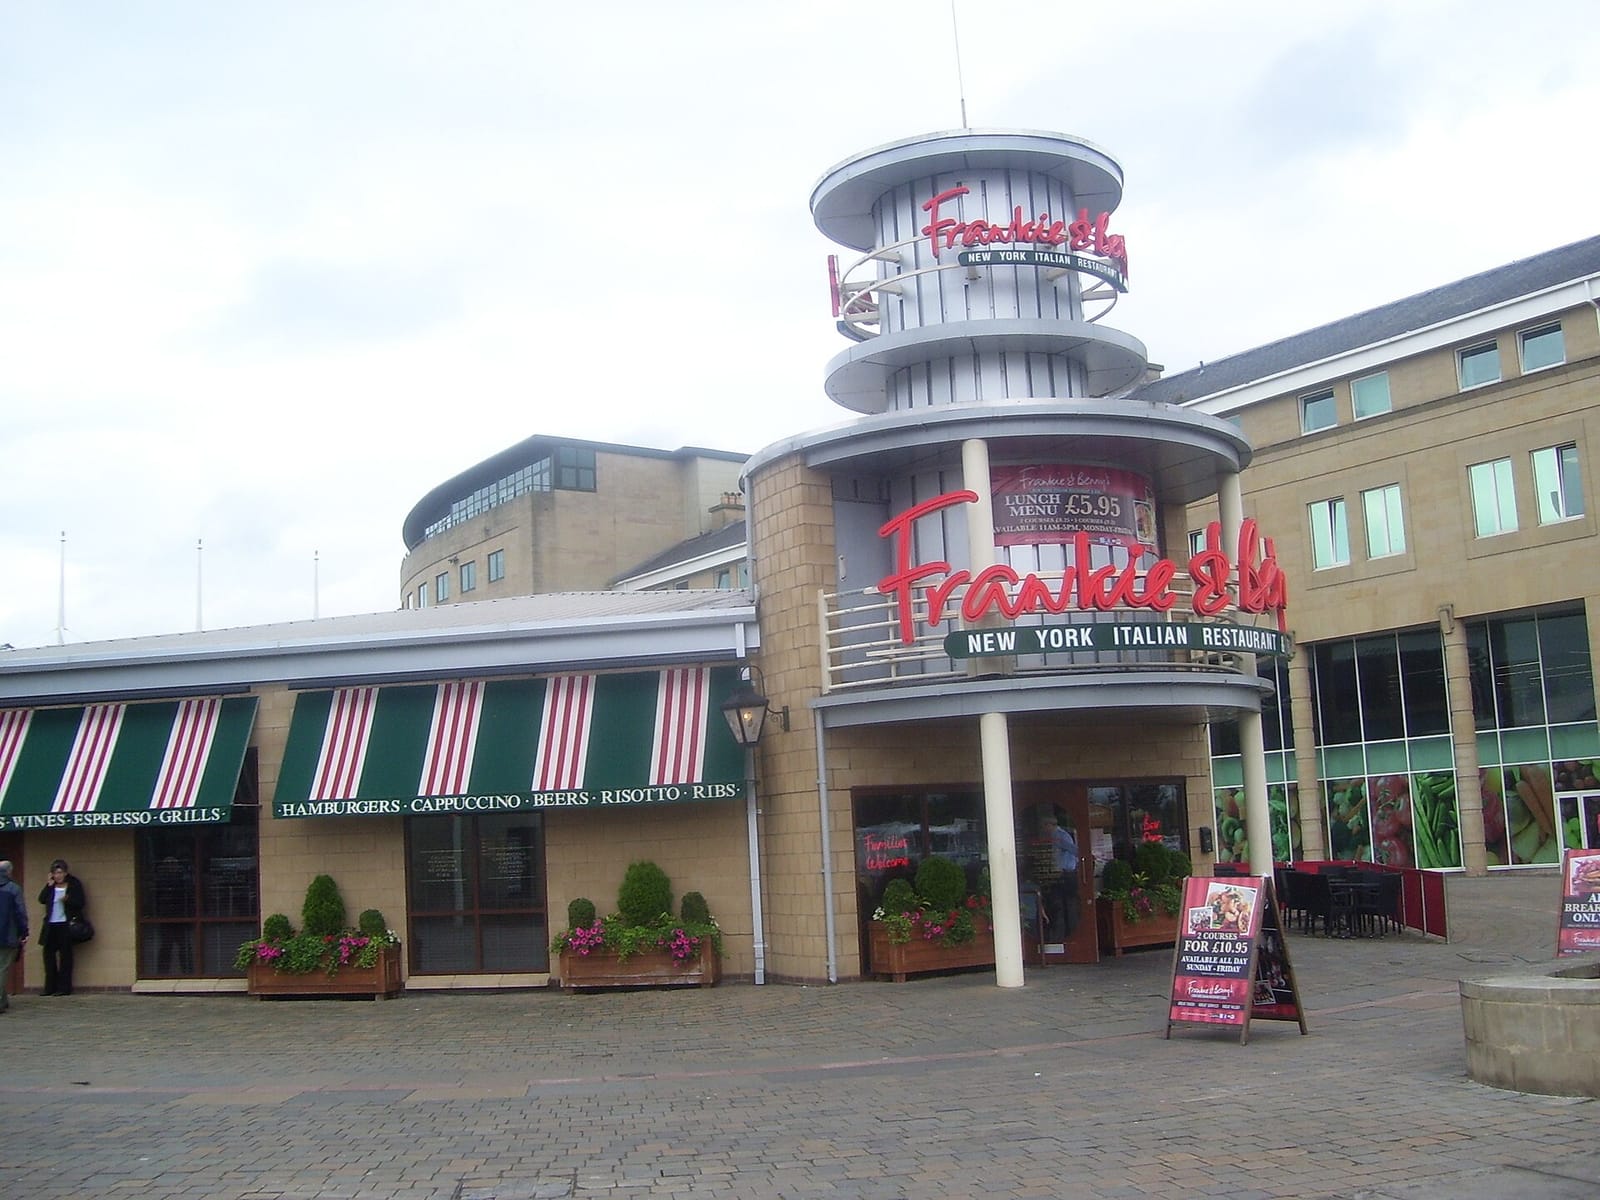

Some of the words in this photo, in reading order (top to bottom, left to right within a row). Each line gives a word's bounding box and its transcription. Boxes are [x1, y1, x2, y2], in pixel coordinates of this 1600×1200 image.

[922, 186, 1067, 258] Frankie
[968, 253, 991, 263] NEW
[1000, 251, 1026, 261] YORK
[1035, 252, 1071, 265] ITALIAN
[1077, 258, 1118, 280] RESTAURANT
[1019, 466, 1067, 489] Frankie
[1005, 493, 1061, 506] LUNCH
[1065, 494, 1121, 517] £5.95
[1009, 505, 1058, 517] MENU
[877, 489, 1177, 645] Frankie
[1188, 521, 1232, 616] &
[967, 631, 1016, 654] NEW
[1034, 626, 1094, 649] YORK
[1113, 625, 1188, 646] ITALIAN
[1202, 627, 1277, 651] RESTAURANT
[281, 800, 400, 817] HAMBURGERS
[411, 795, 520, 812] CAPPUCCINO
[533, 791, 589, 807] BEERS
[600, 786, 680, 804] RISOTTO
[692, 783, 736, 799] RIBS
[12, 815, 66, 828] WINES
[74, 811, 151, 826] ESPRESSO
[159, 808, 221, 823] GRILLS
[1573, 913, 1600, 922] ONL
[1184, 940, 1209, 952] FOR
[1212, 941, 1248, 953] £10.95
[1203, 932, 1238, 940] COURSES
[1181, 955, 1218, 964] AVAILABLE
[1219, 956, 1232, 964] ALL
[1234, 957, 1248, 965] DAY
[1186, 963, 1212, 972] SUNDAY
[1216, 965, 1241, 973] FRIDAY
